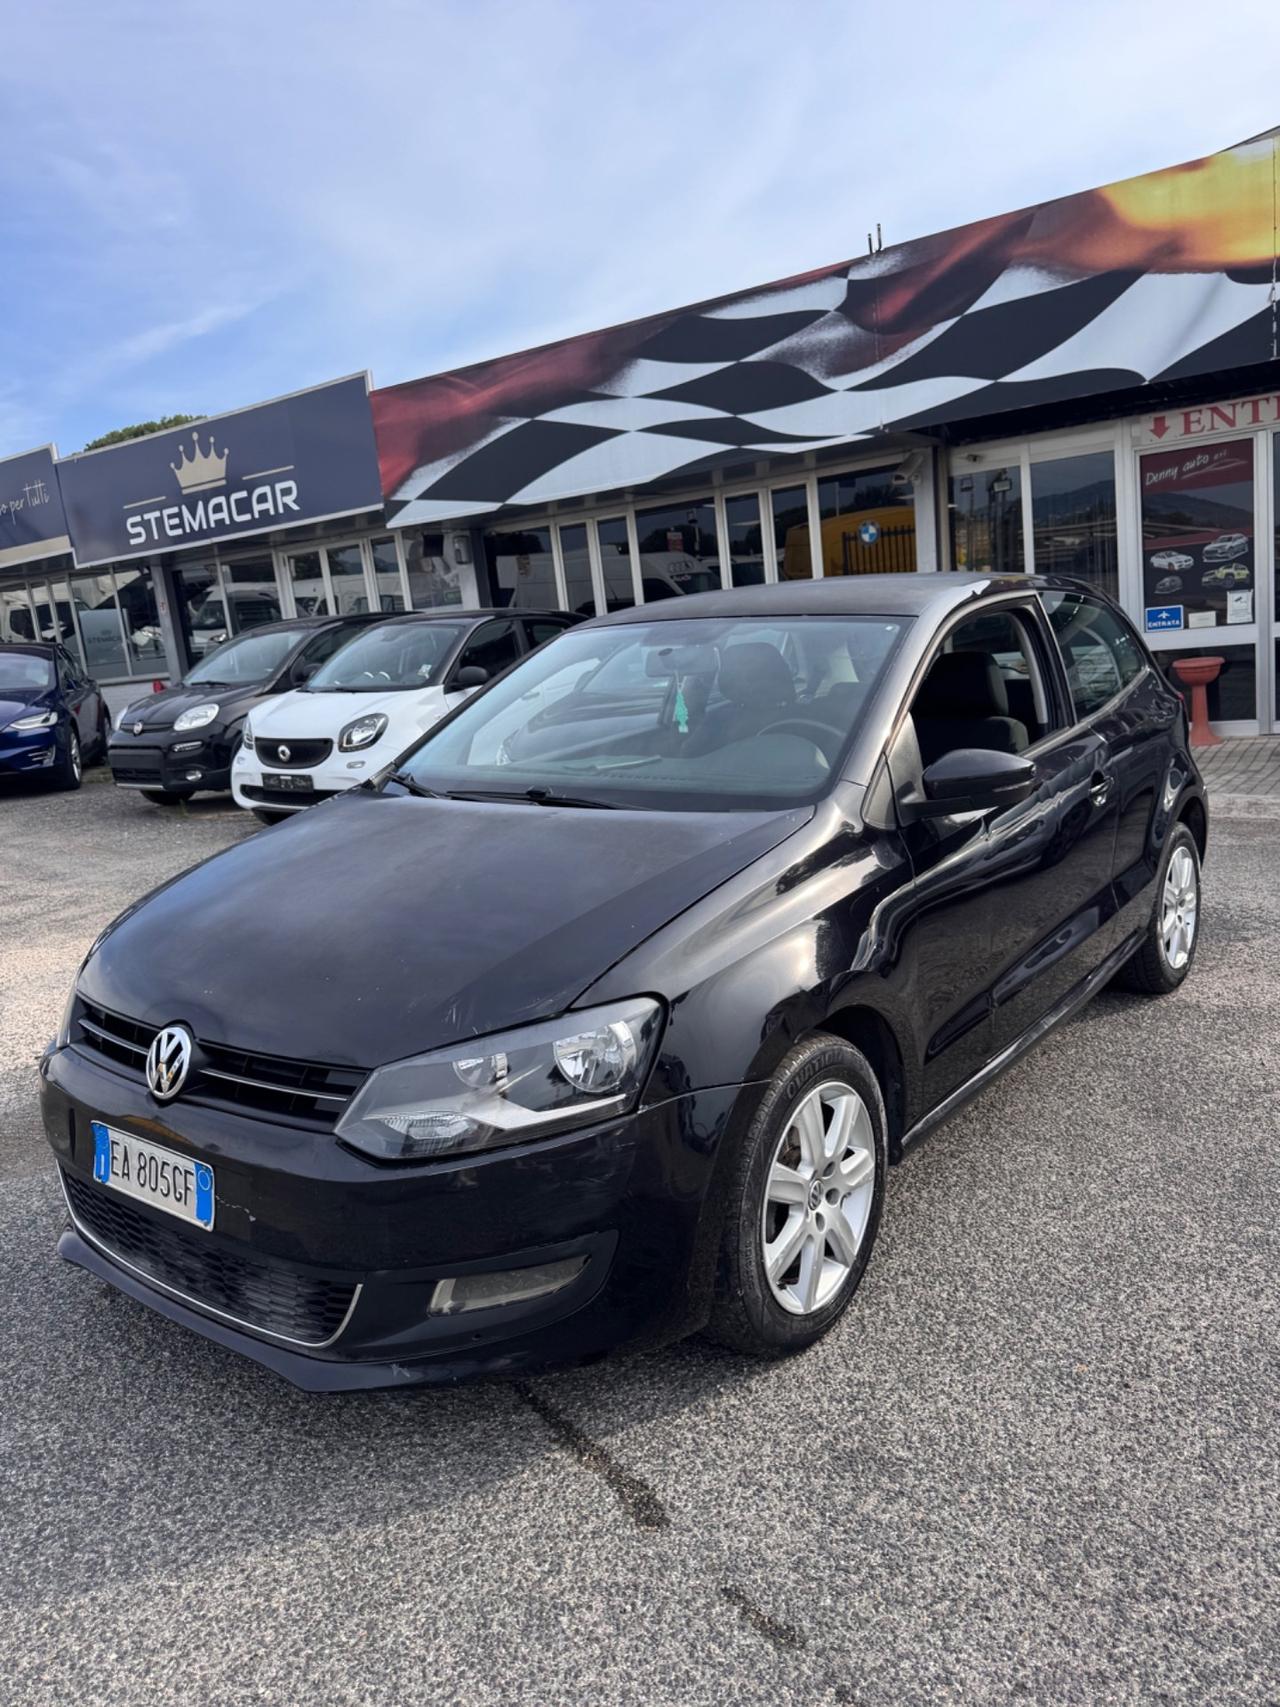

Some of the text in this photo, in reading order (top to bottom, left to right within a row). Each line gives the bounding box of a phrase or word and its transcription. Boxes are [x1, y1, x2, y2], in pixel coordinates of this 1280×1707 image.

[1145, 466, 1179, 486] Denny
[1182, 454, 1209, 472] auto
[126, 480, 300, 545] STEMACAR
[1148, 619, 1180, 629] ENTRATA
[110, 1140, 194, 1206] EA 805GF
